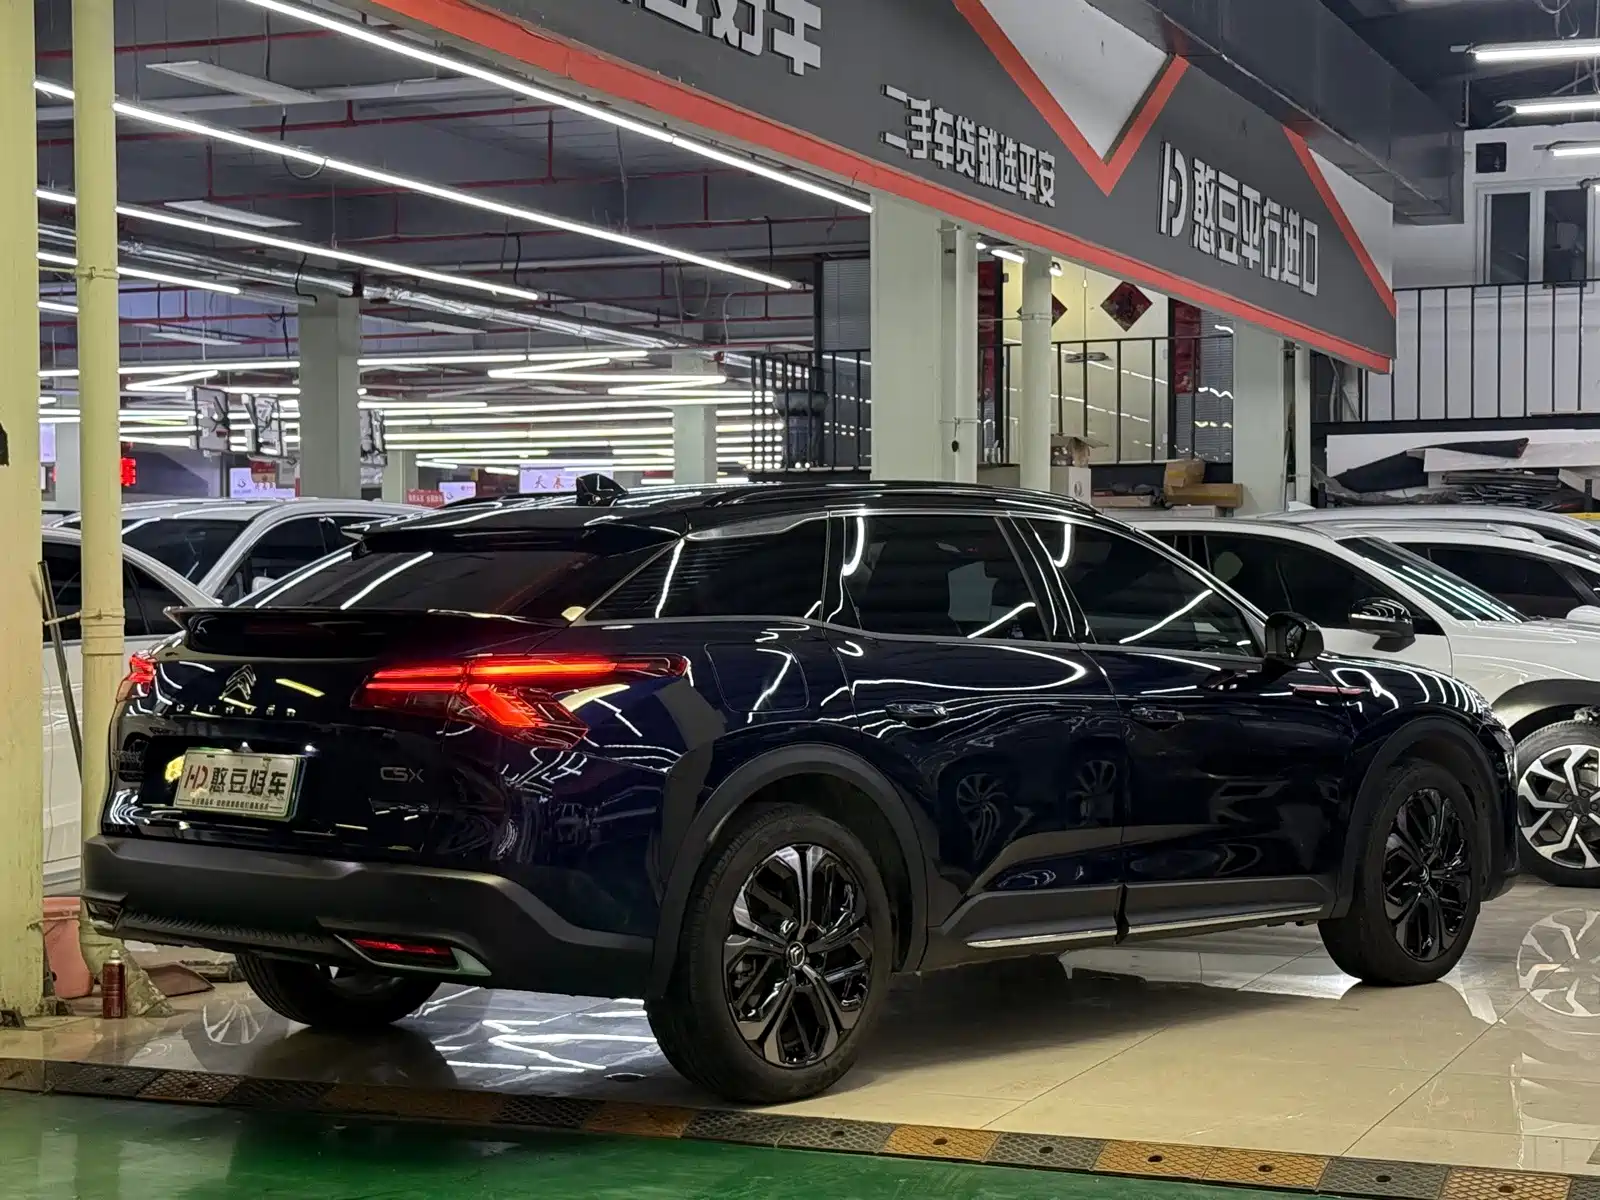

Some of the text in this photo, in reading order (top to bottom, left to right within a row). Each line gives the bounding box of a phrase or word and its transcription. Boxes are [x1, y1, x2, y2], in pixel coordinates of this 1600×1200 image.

[882, 84, 1055, 207] 二手车贷就选平安
[1193, 157, 1319, 296] 憨豆平行进口
[209, 767, 288, 797] 憨豆好车
